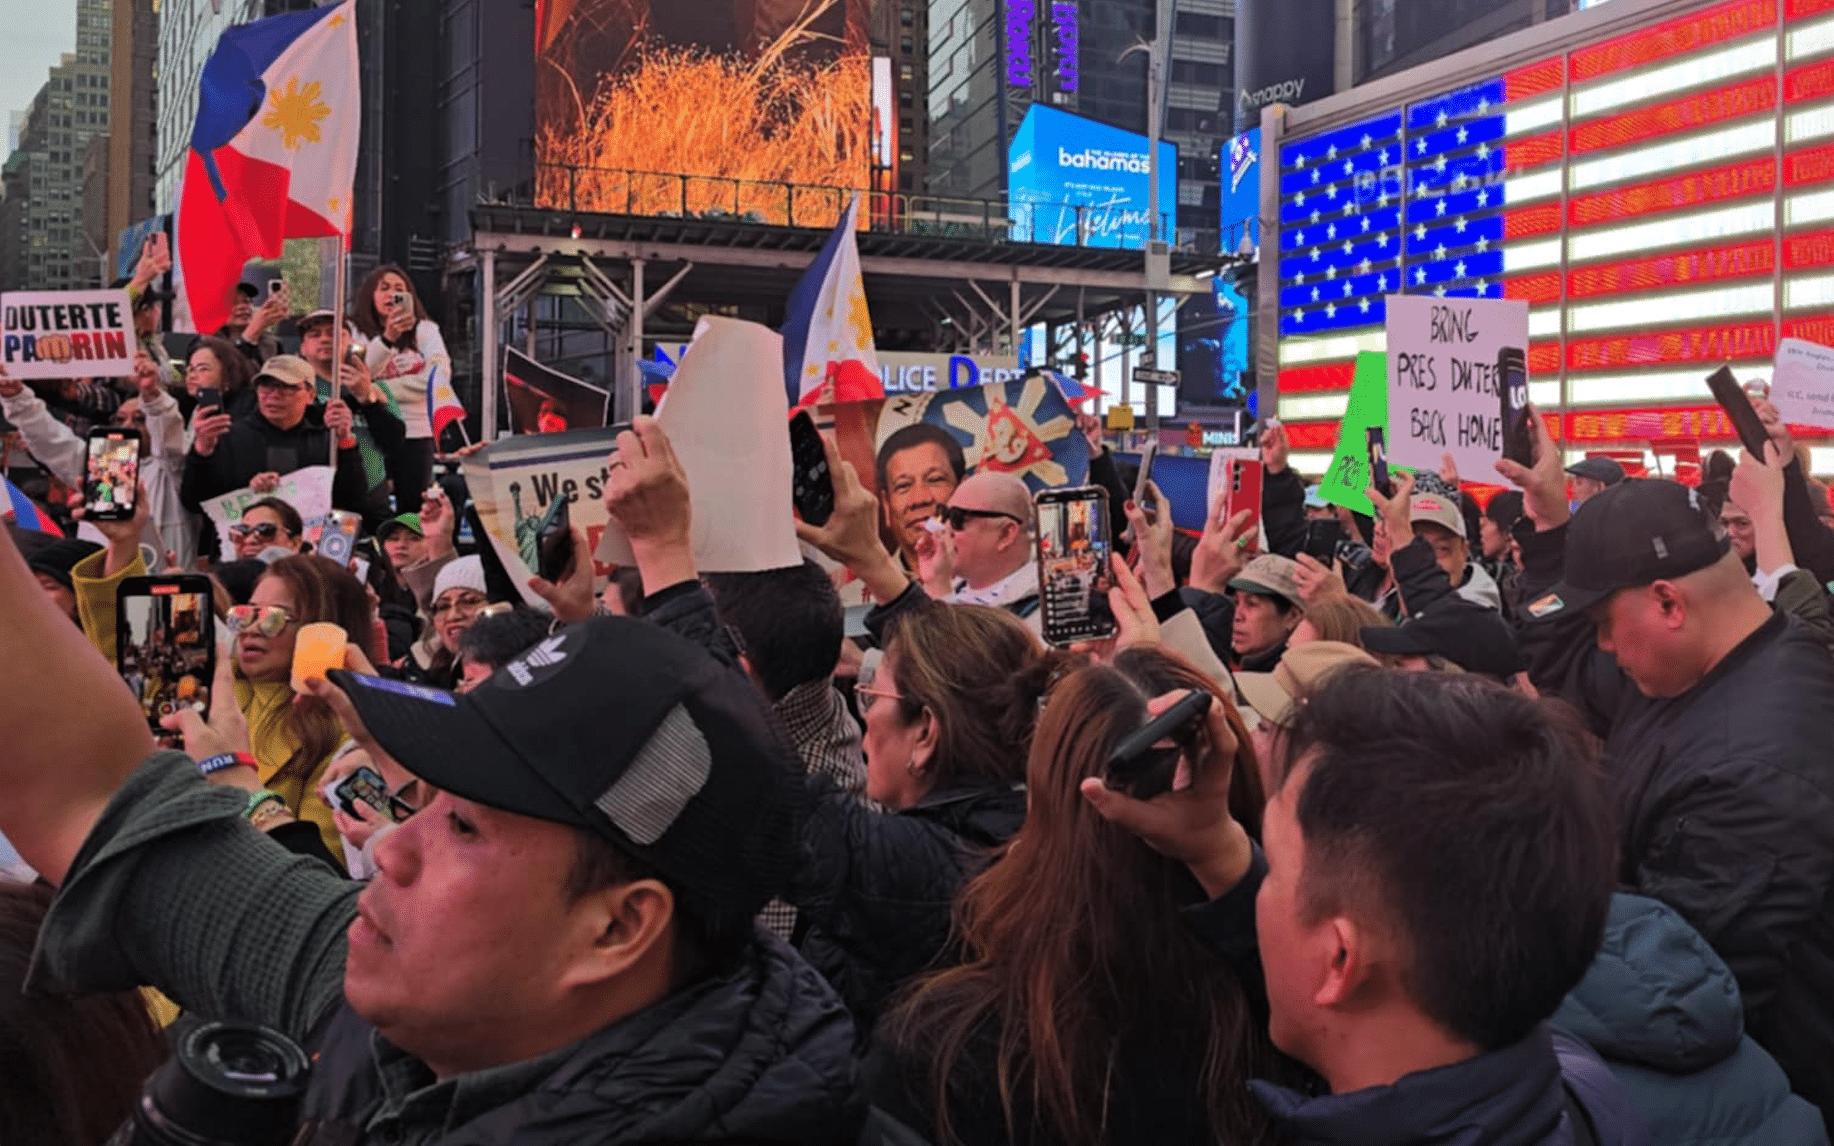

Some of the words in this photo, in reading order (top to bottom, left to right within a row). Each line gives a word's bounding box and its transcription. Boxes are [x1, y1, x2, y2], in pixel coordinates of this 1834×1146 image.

[5, 302, 122, 330] DUTERTE
[1430, 305, 1479, 343] BRING
[882, 363, 937, 392] LICE
[1397, 352, 1436, 391] PRES
[1450, 357, 1501, 398] DUTER
[1411, 407, 1447, 447] BACK
[1458, 412, 1502, 451] HOME
[531, 472, 578, 507] We
[585, 467, 611, 500] st
